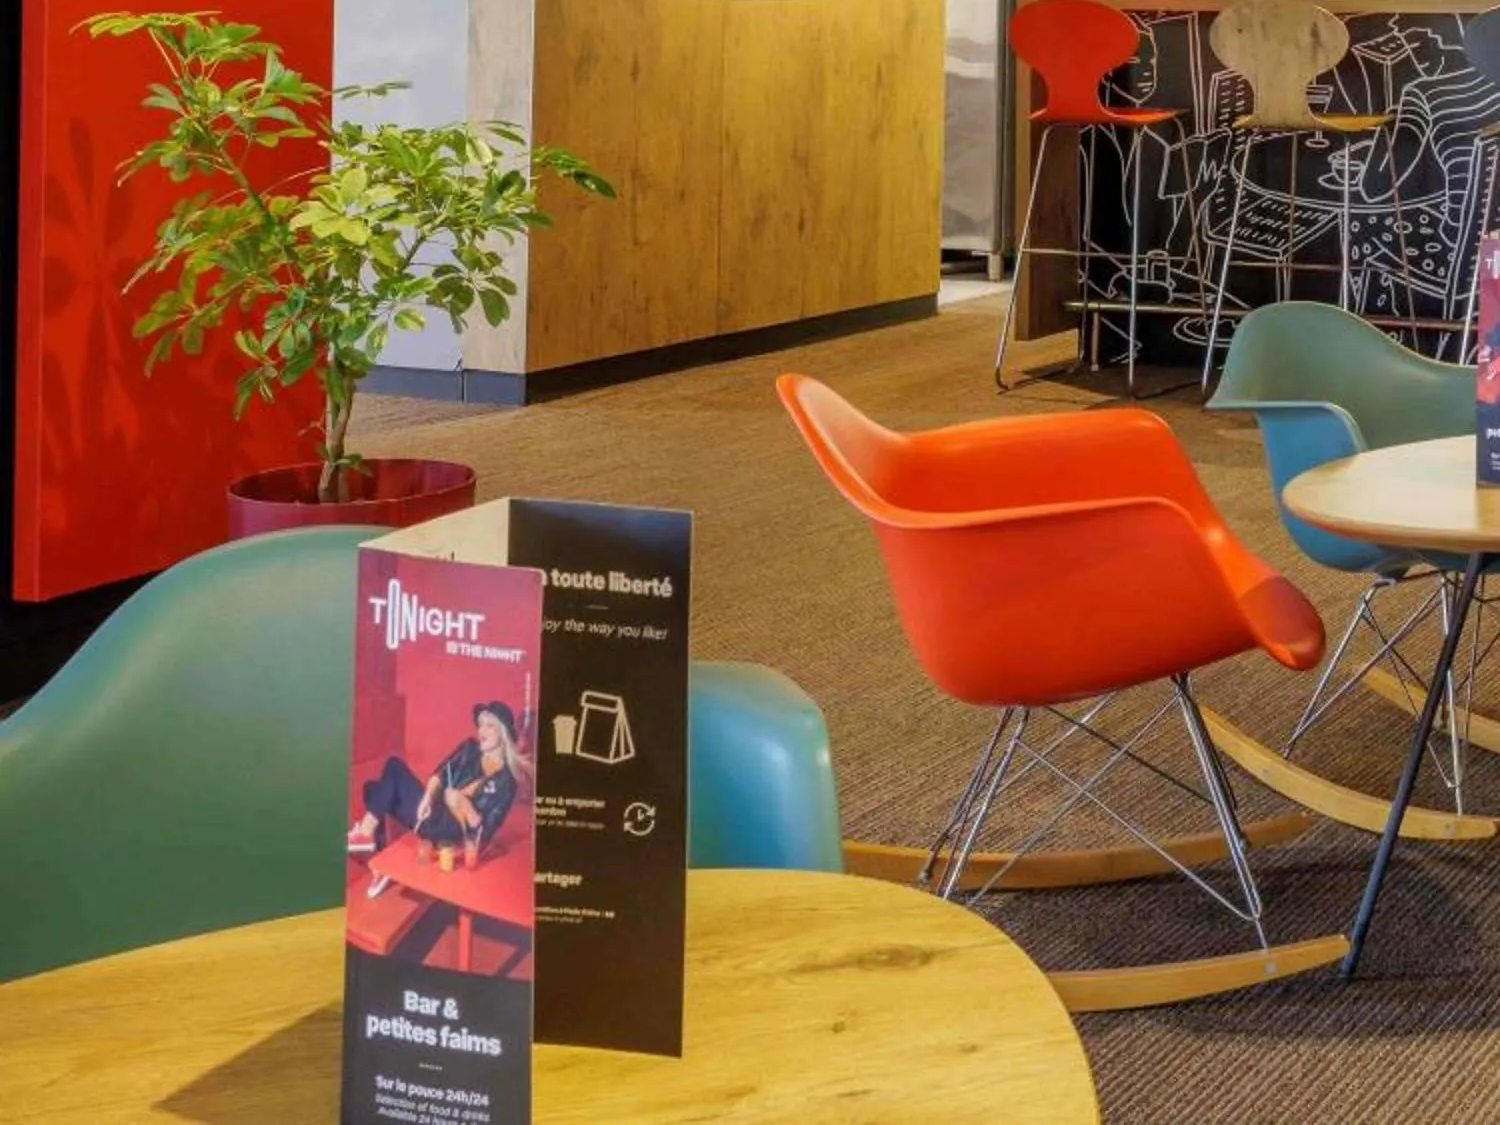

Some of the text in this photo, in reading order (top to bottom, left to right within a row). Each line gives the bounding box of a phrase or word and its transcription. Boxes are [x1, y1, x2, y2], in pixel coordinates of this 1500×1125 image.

[550, 568, 606, 591] toute
[608, 570, 674, 598] liberté
[368, 578, 486, 650] TONIGHT
[563, 618, 586, 633] the
[588, 622, 616, 638] way
[617, 625, 641, 639] you
[460, 643, 483, 658] THE
[484, 646, 522, 663] NIGHT
[534, 872, 583, 888] artager
[403, 989, 460, 1020] Bar &
[365, 1014, 503, 1056] petites faims
[375, 1075, 490, 1107] Sur le pouce 24h/24
